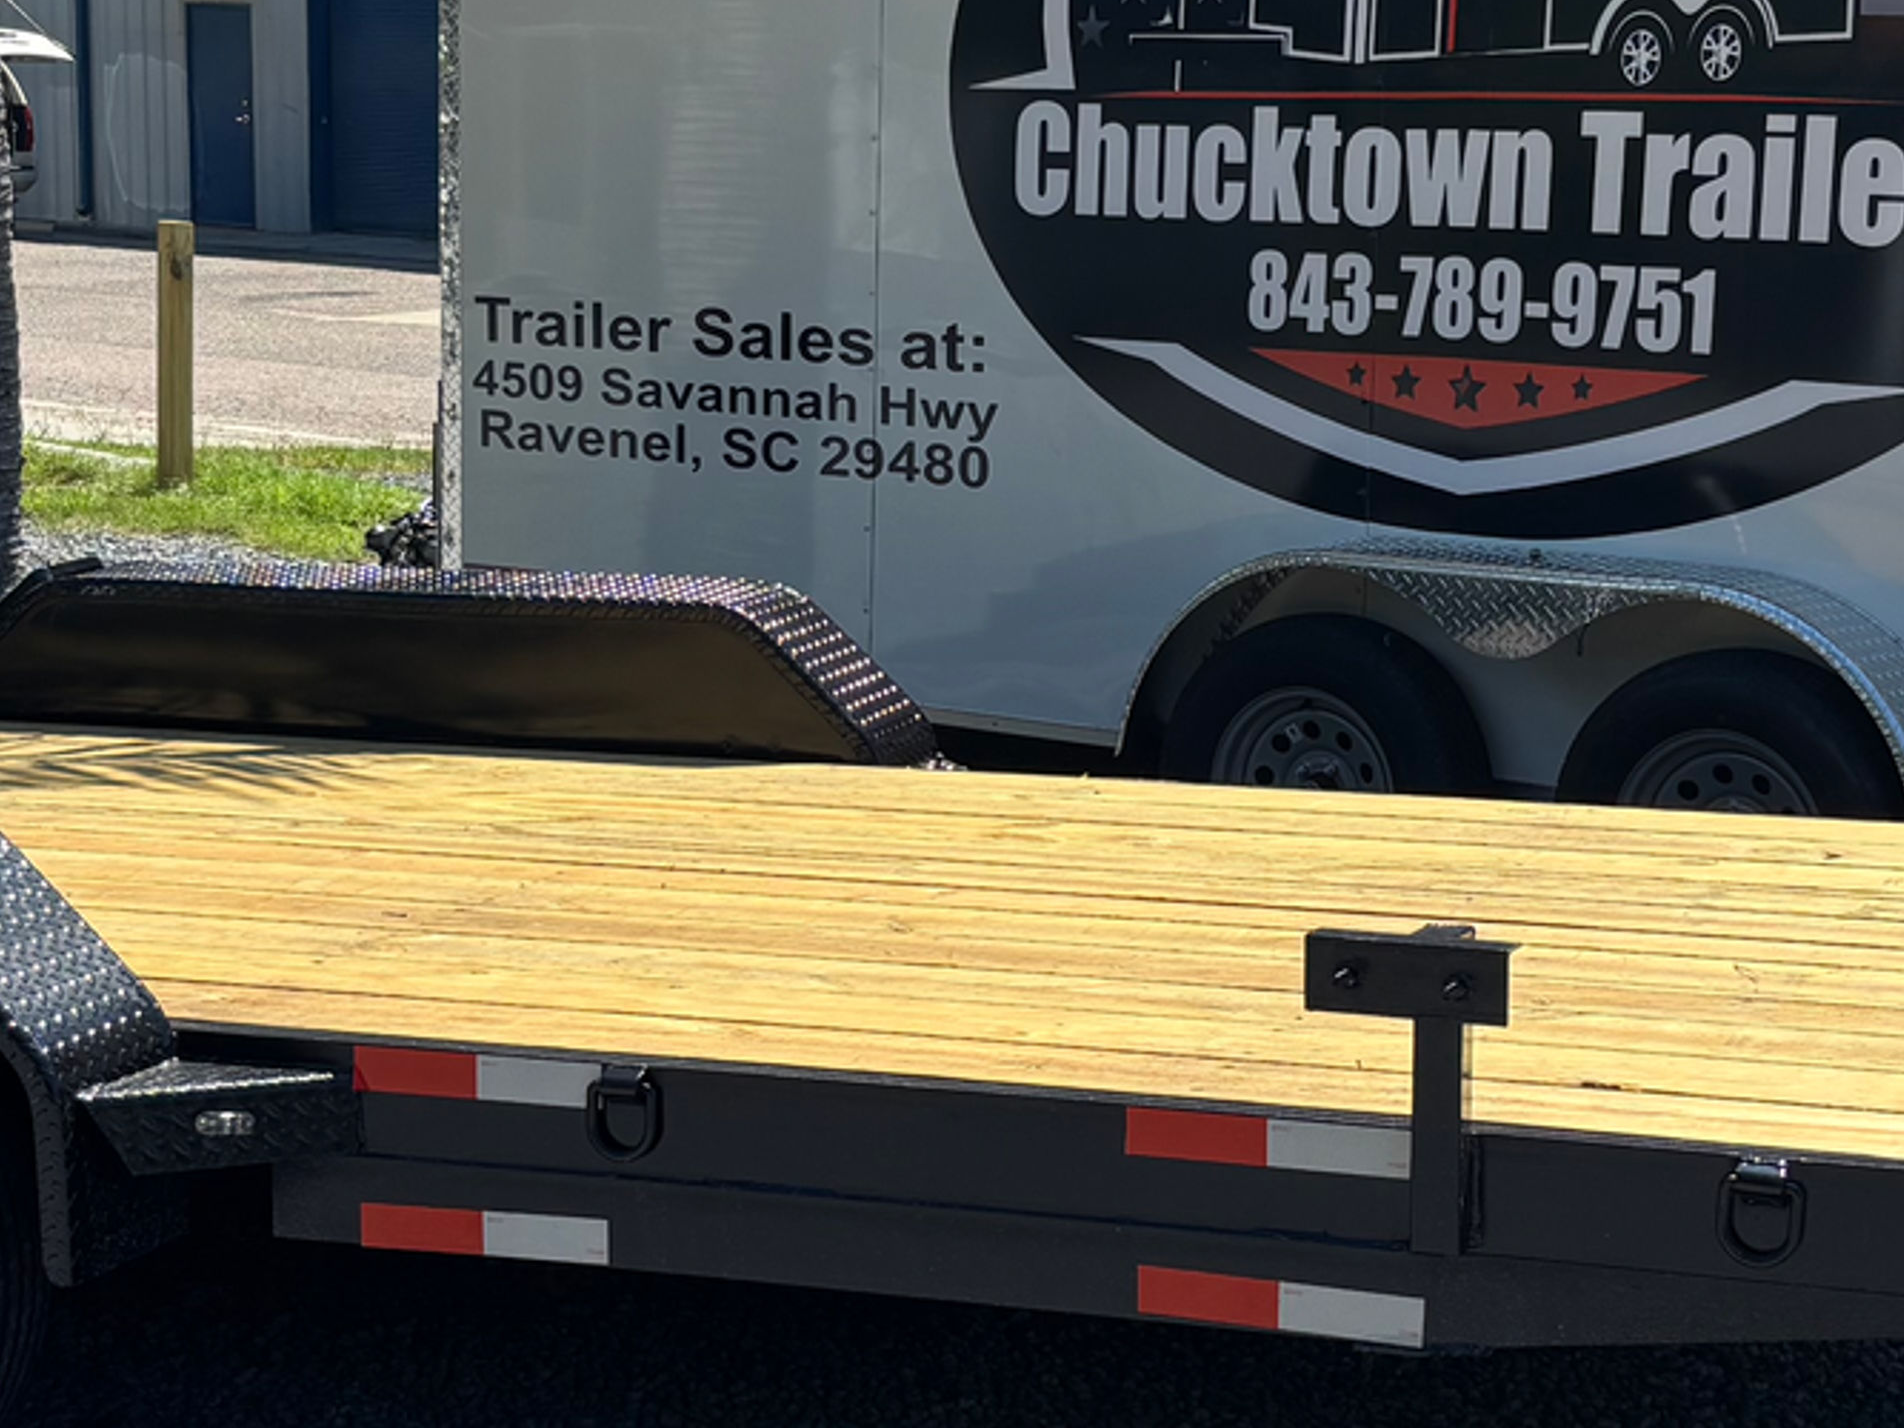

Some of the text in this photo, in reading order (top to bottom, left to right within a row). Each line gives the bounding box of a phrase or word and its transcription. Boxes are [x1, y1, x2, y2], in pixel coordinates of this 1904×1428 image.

[1014, 101, 1557, 232] Chucktown
[474, 296, 987, 373] Trailer Sales at:
[1247, 251, 1717, 356] 843-789-9751
[473, 360, 999, 442] 4509 Savannah Hwy
[480, 409, 991, 489] Ravenel, SC 29480
